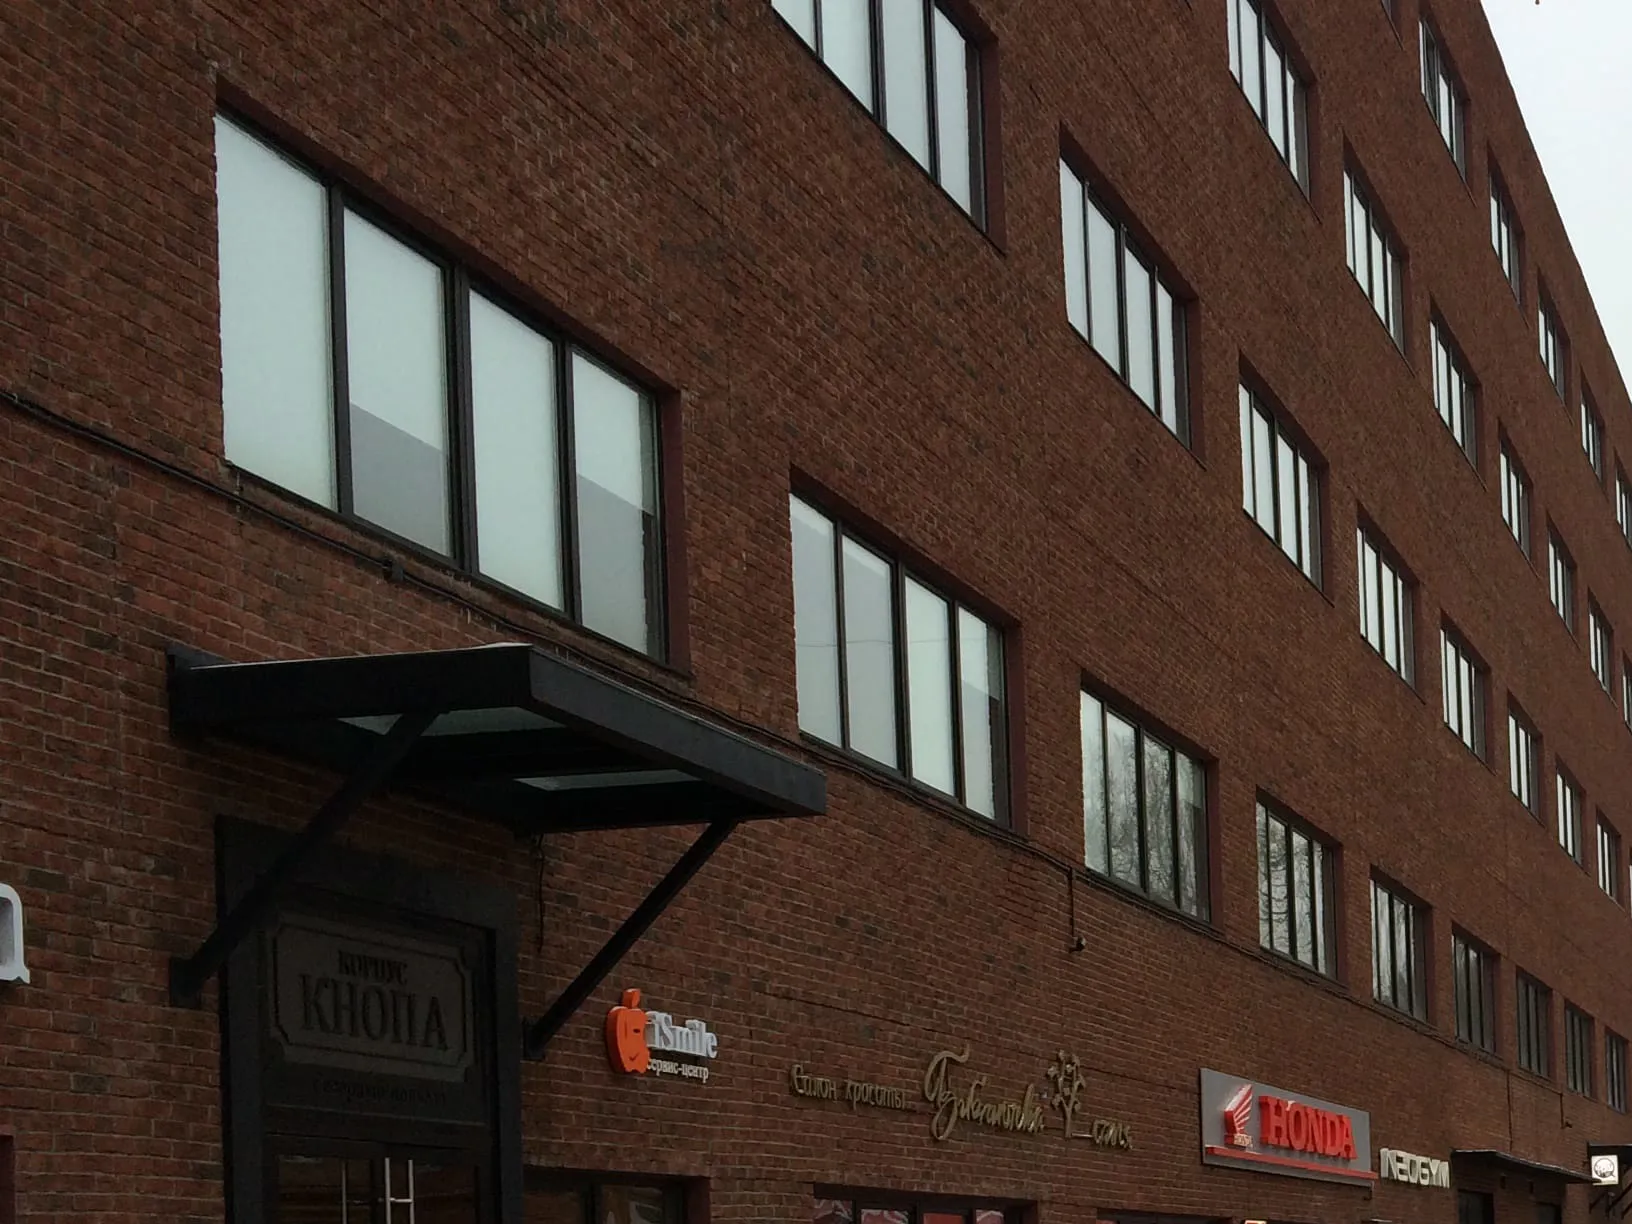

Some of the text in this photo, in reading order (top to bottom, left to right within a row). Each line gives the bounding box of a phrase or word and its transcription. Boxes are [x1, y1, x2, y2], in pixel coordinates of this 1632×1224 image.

[299, 973, 448, 1051] КНОПА
[1259, 1095, 1357, 1160] HONDA
[1380, 1147, 1450, 1189] NEOGYM
